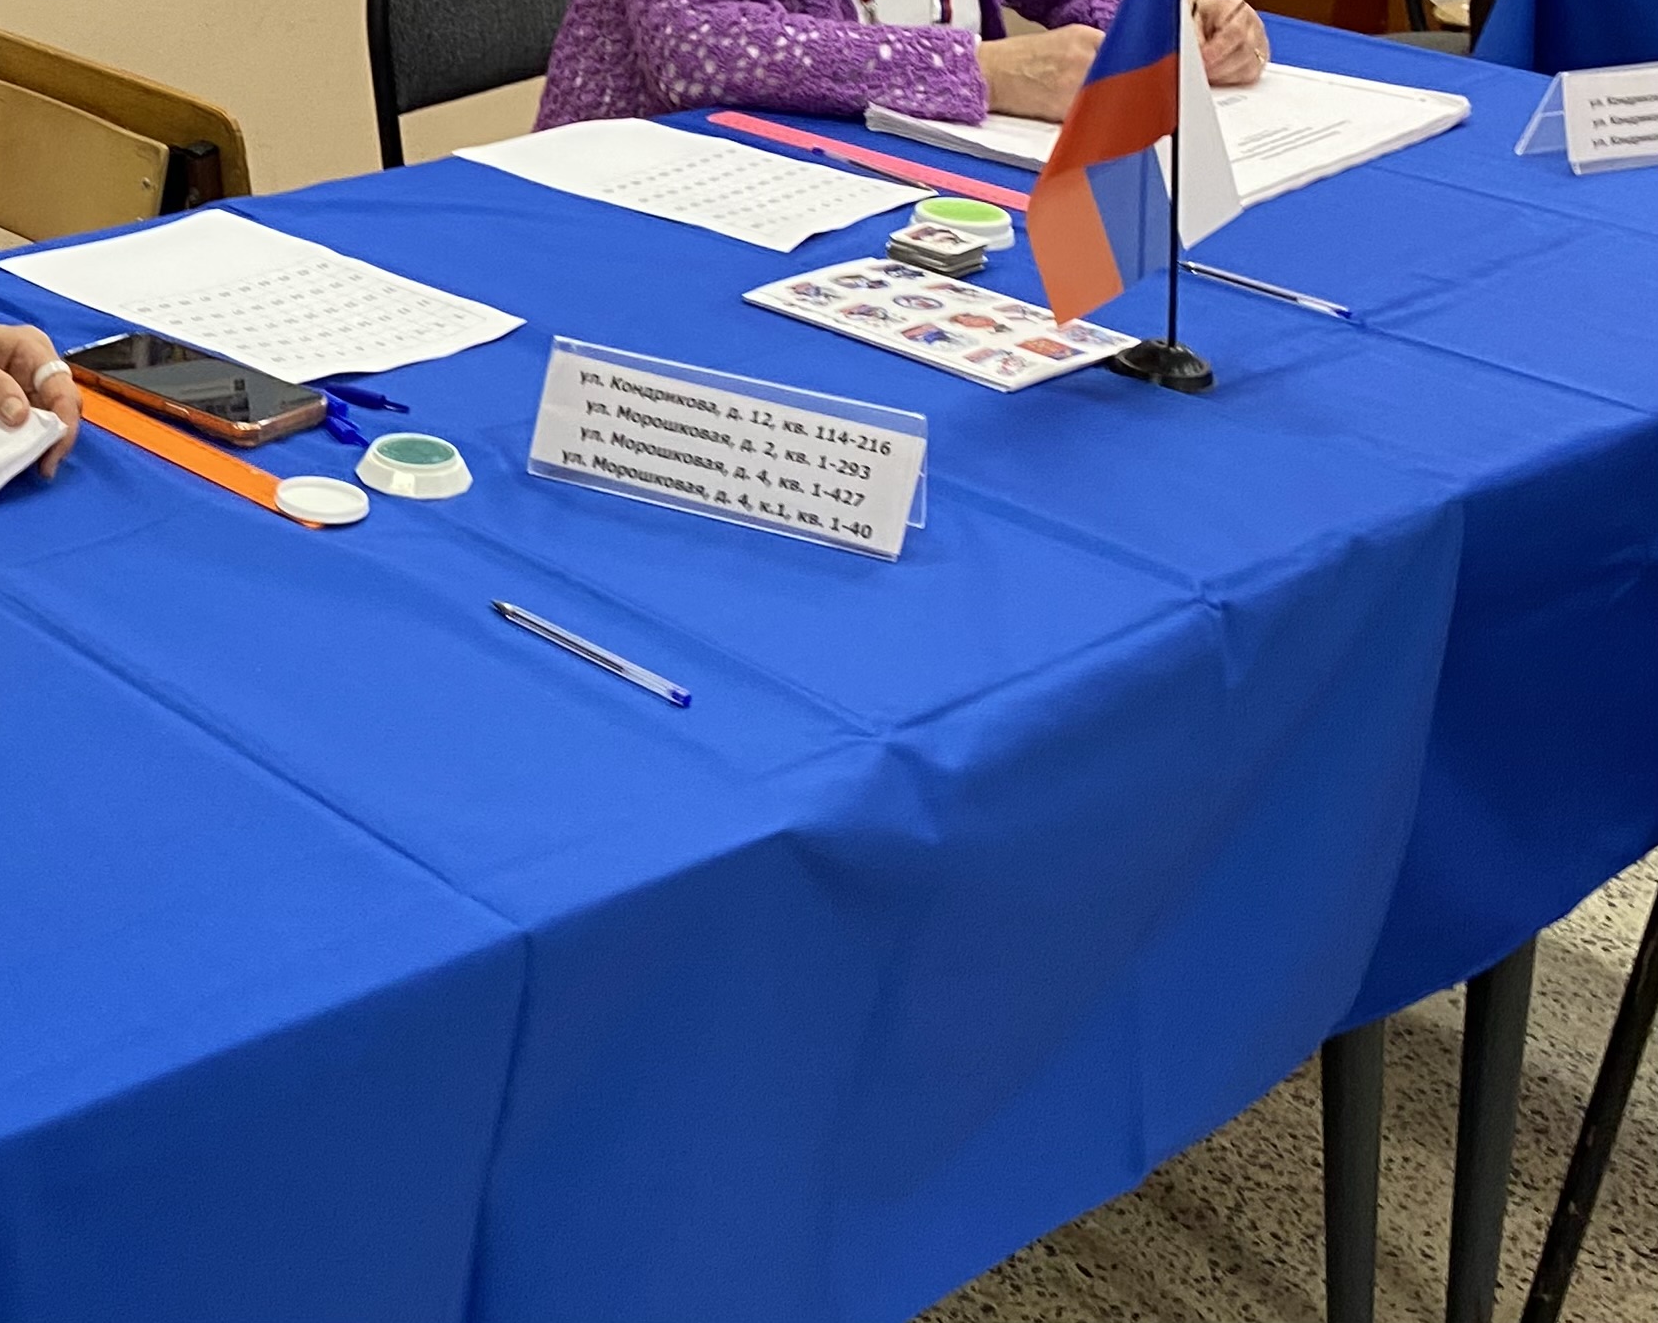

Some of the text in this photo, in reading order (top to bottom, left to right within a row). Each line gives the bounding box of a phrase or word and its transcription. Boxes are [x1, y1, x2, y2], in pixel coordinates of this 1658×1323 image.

[580, 371, 892, 456] ул. Кондрикова, д. 12, кв. 114-216
[586, 400, 871, 480] ул. Морошковая, д. 2, кв. 1-293
[562, 450, 587, 467] ул.
[593, 454, 709, 500] Морошковая,
[714, 490, 732, 504] д.
[737, 493, 753, 512] 4,
[797, 510, 824, 528] кв.
[829, 517, 873, 539] 1-40
[580, 427, 865, 507] ул. Морошковая, д. 4, кв. 1-427
